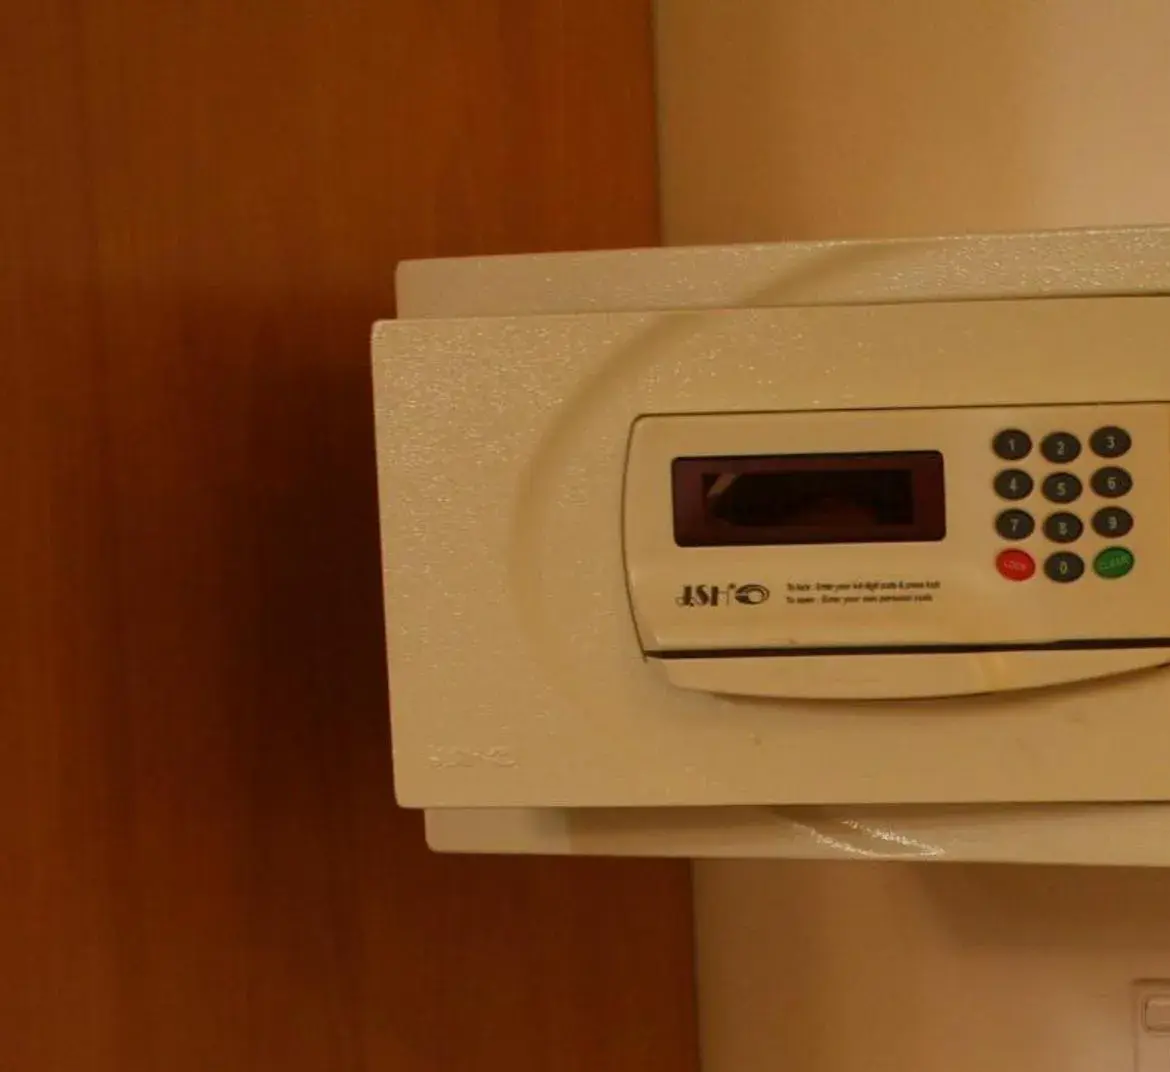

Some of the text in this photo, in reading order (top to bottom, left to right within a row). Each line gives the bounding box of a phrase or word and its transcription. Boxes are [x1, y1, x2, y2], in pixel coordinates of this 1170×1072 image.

[1056, 441, 1065, 455] 2
[1106, 436, 1115, 449] 3
[1009, 477, 1116, 496] 4 5 6
[1010, 516, 1117, 535] 7 8 9
